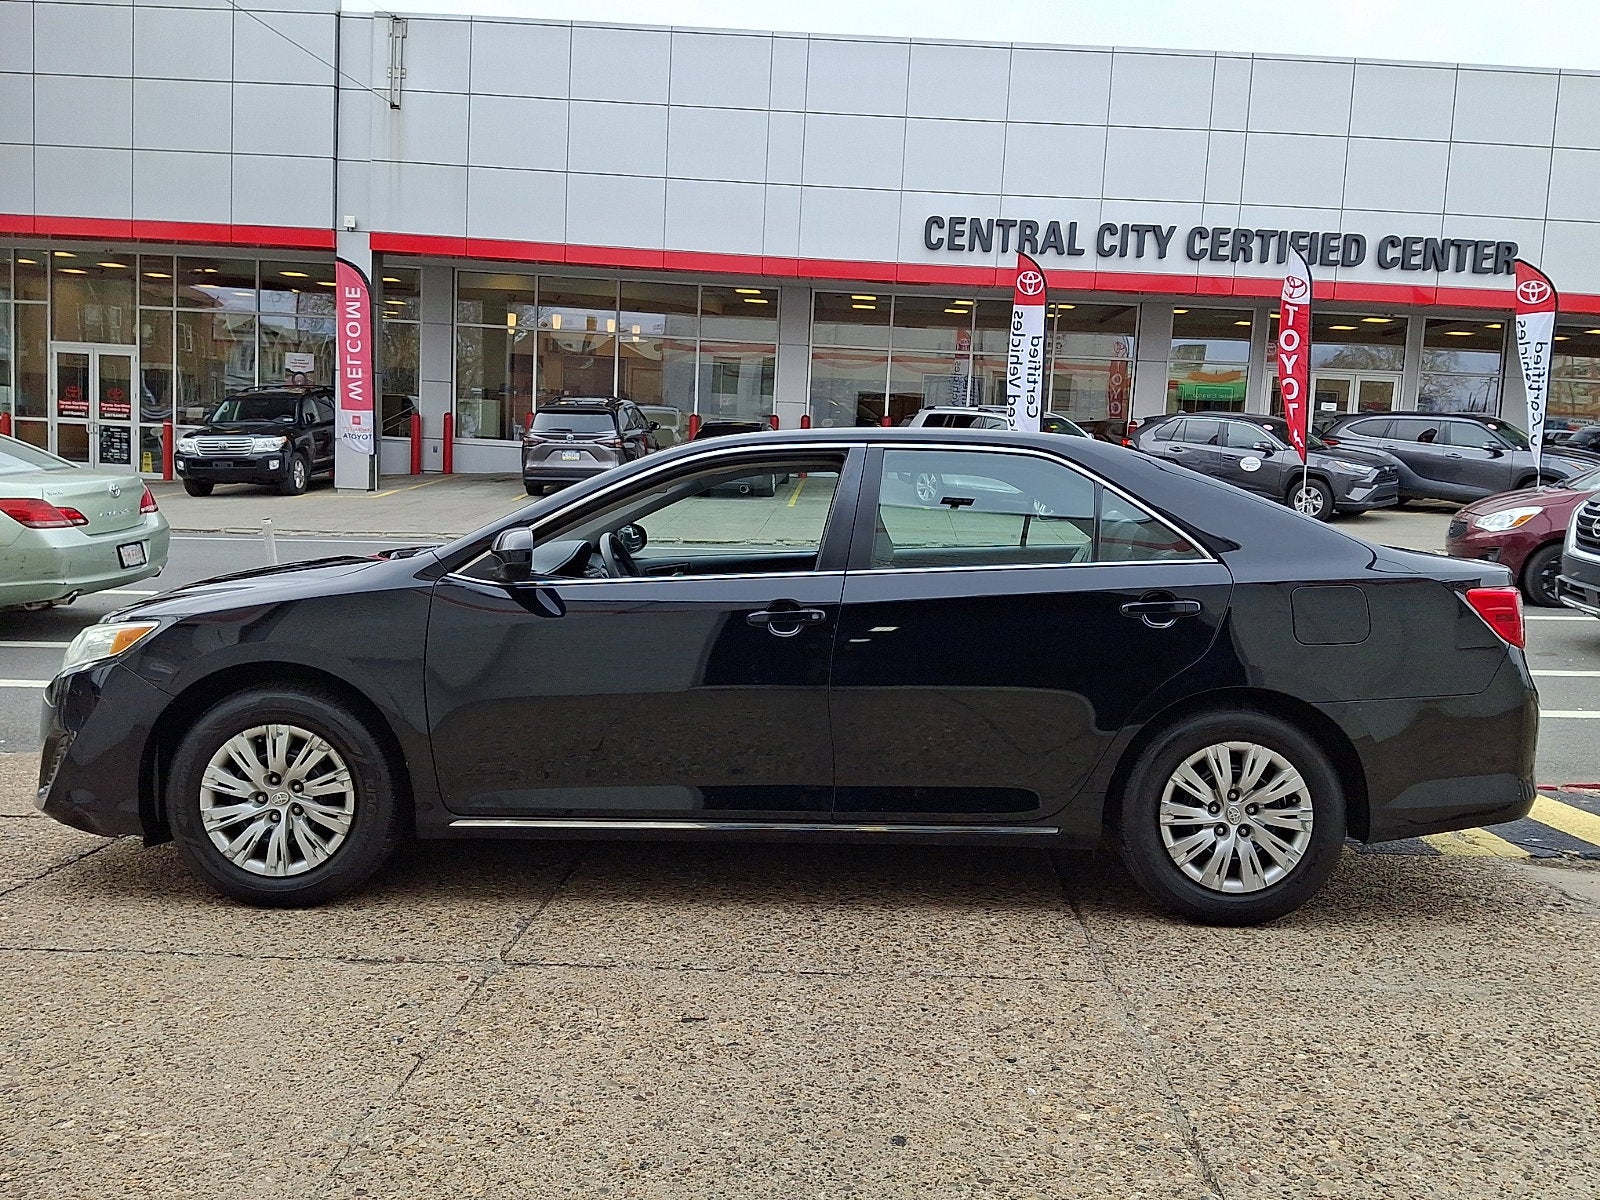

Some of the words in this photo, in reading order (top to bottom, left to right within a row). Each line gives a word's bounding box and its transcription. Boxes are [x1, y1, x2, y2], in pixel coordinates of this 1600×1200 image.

[924, 215, 1086, 256] CENTRAL
[1096, 222, 1178, 260] CITY
[1186, 226, 1367, 267] CERTIFIED
[1377, 234, 1520, 275] CENTER
